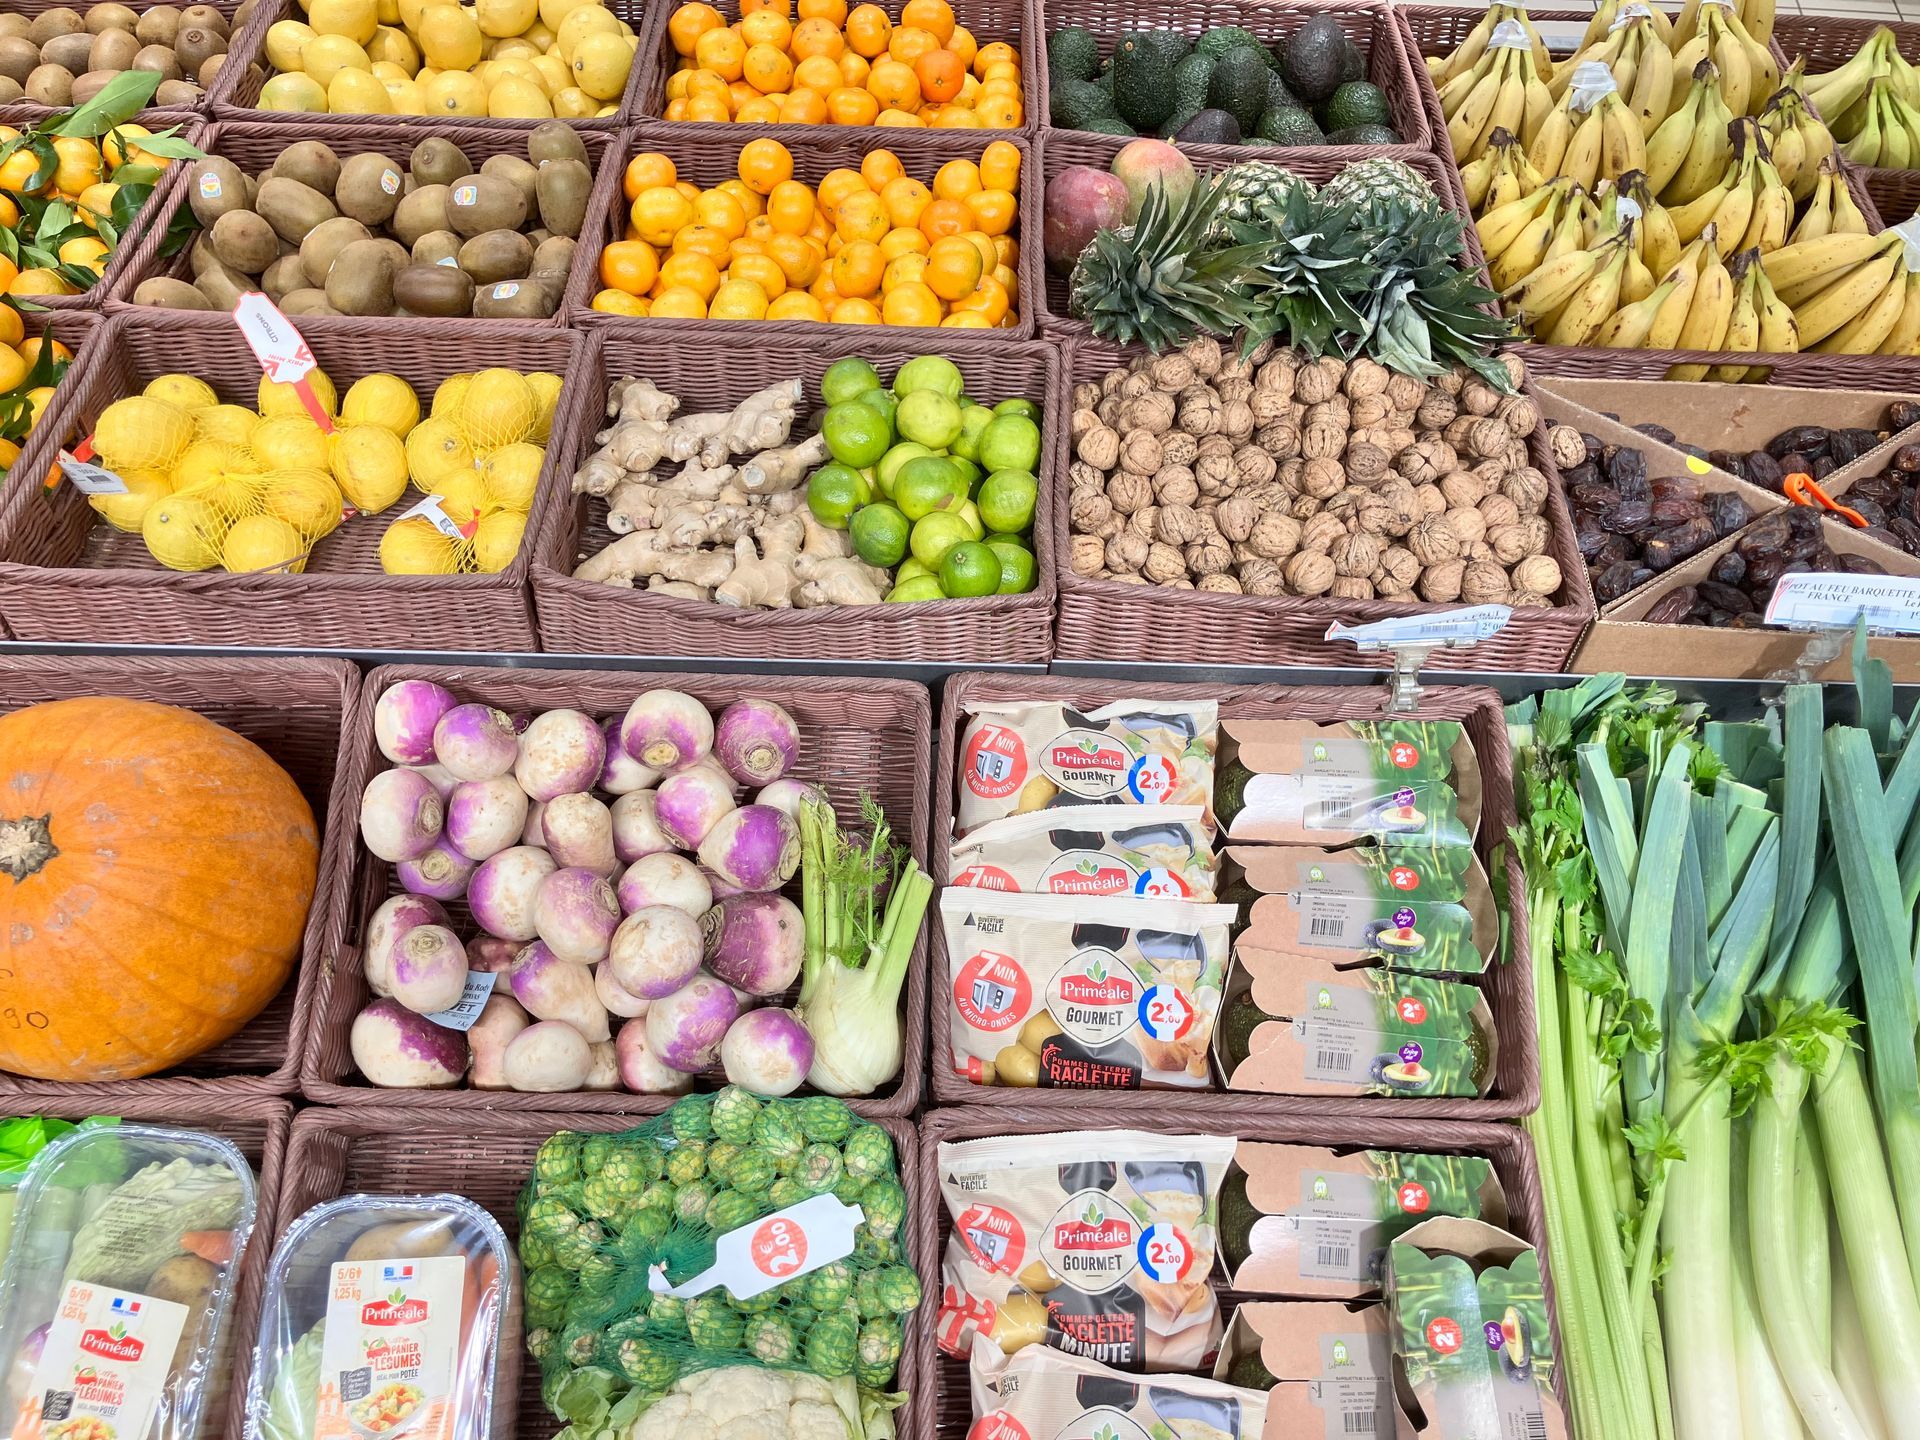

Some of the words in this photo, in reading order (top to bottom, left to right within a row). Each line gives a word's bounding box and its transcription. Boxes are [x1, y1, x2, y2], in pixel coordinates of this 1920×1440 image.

[256, 313, 278, 343] CITRONS
[1808, 592, 1853, 602] FRANCE
[1828, 585, 1850, 593] FEU
[1851, 586, 1916, 598] BARQUETTE
[980, 725, 1001, 748] 7
[1056, 751, 1121, 767] Priméale
[967, 769, 974, 778] AU
[971, 778, 1016, 795] MICRO-ONDES
[1063, 770, 1116, 787] GOURMET
[968, 868, 985, 887] 7
[1053, 874, 1125, 893] Priméale
[977, 923, 1004, 933] FACILE
[978, 950, 1000, 977] 7
[1064, 982, 1130, 1000] Priméale
[959, 997, 967, 1007] AU
[963, 1006, 1017, 1028] MICRO-ONDES
[1066, 1006, 1124, 1026] GOURMET
[1052, 1056, 1088, 1068] POMMES
[1104, 1065, 1132, 1074] TERRE
[1050, 1063, 1132, 1086] RACLETTE
[960, 1180, 988, 1190] FACILE
[1404, 1189, 1423, 1207] 2€
[971, 1204, 992, 1227] 7
[1059, 1229, 1128, 1245] Priméale
[1063, 1255, 1122, 1271] GOURMET
[338, 1268, 355, 1280] 5/6
[335, 1287, 351, 1301] 1,25
[352, 1287, 361, 1301] kg
[366, 1306, 425, 1320] Priméale
[1095, 1313, 1106, 1323] DE
[1108, 1313, 1136, 1323] TERRE
[84, 1333, 140, 1358] Priméale
[391, 1343, 418, 1354] PANIER
[1060, 1333, 1132, 1363] MINUTE
[375, 1353, 421, 1371] LÉGUMES
[400, 1369, 419, 1380] POTÉE
[80, 1384, 124, 1406] LÉGUMES
